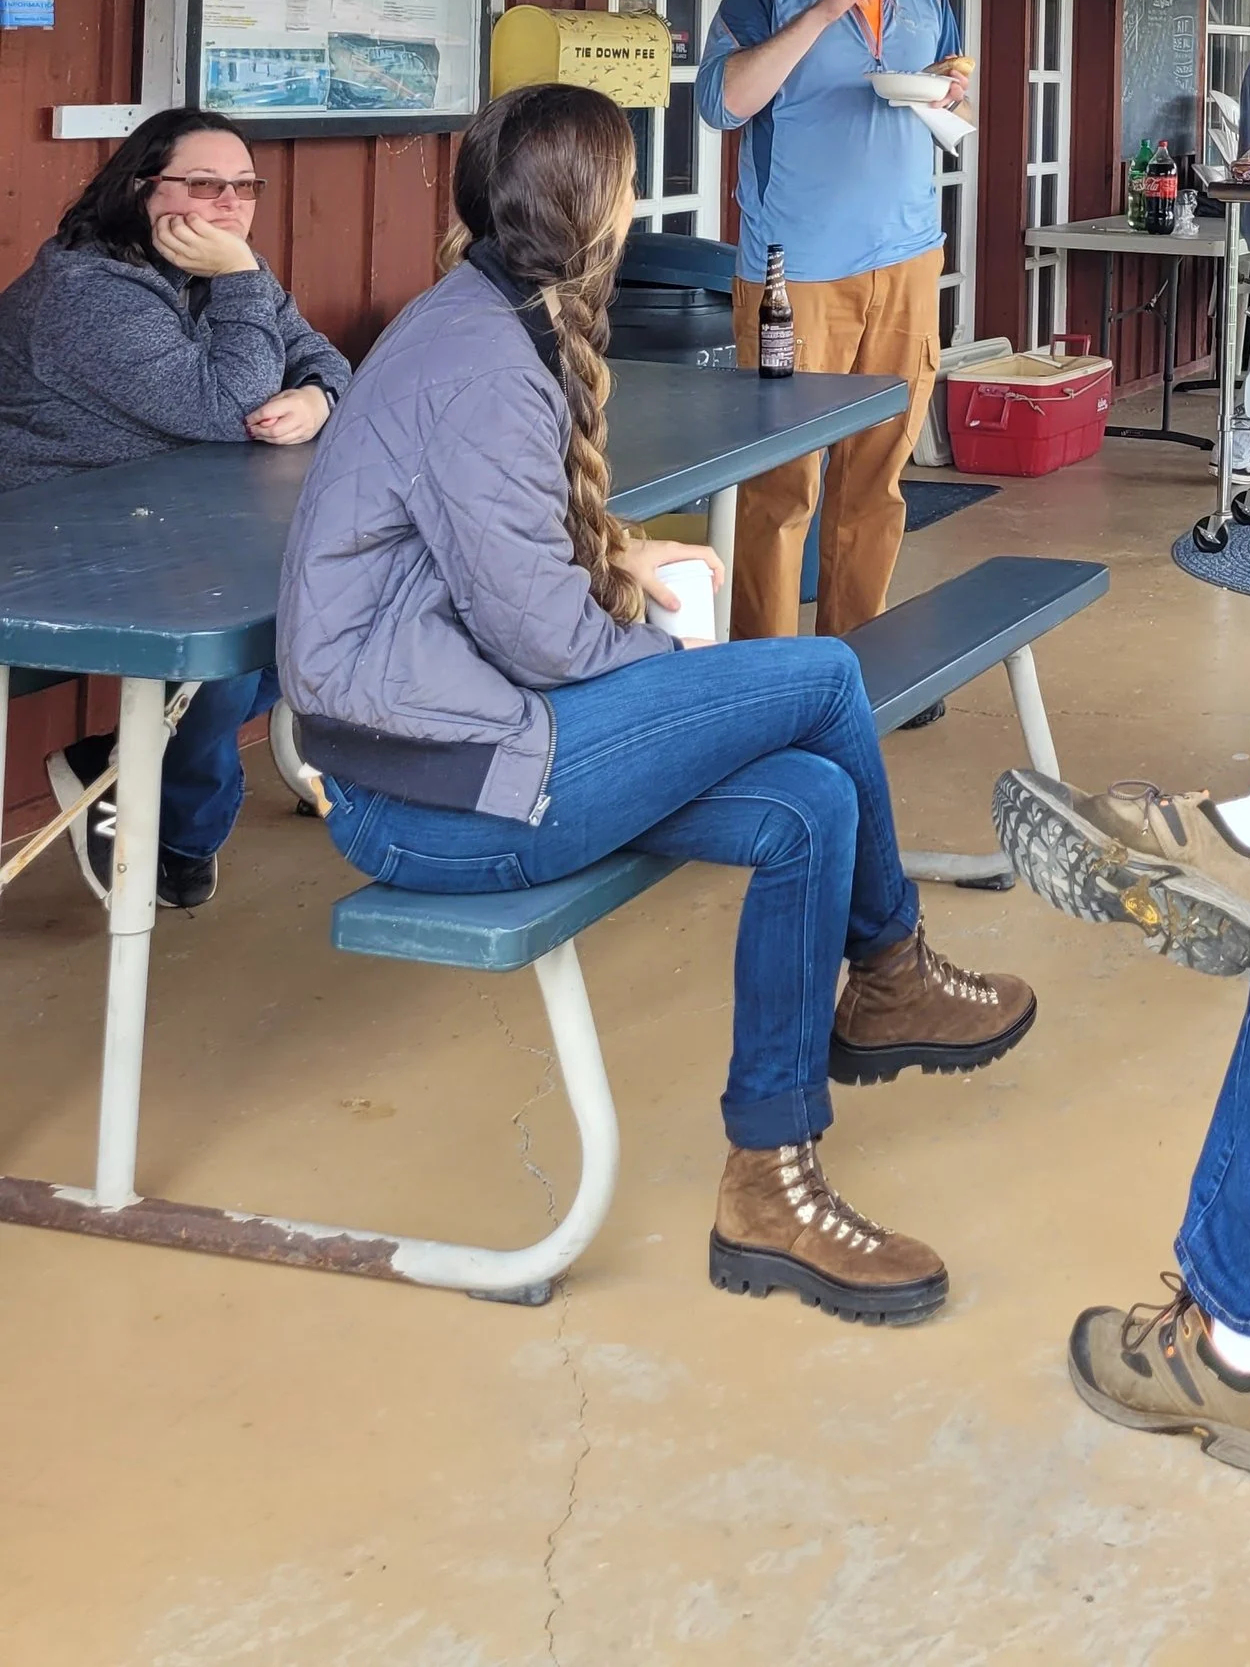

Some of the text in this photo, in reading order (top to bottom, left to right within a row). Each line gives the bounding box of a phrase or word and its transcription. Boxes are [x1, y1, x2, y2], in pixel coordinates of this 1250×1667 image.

[575, 47, 655, 59] TIE DOWN FEE
